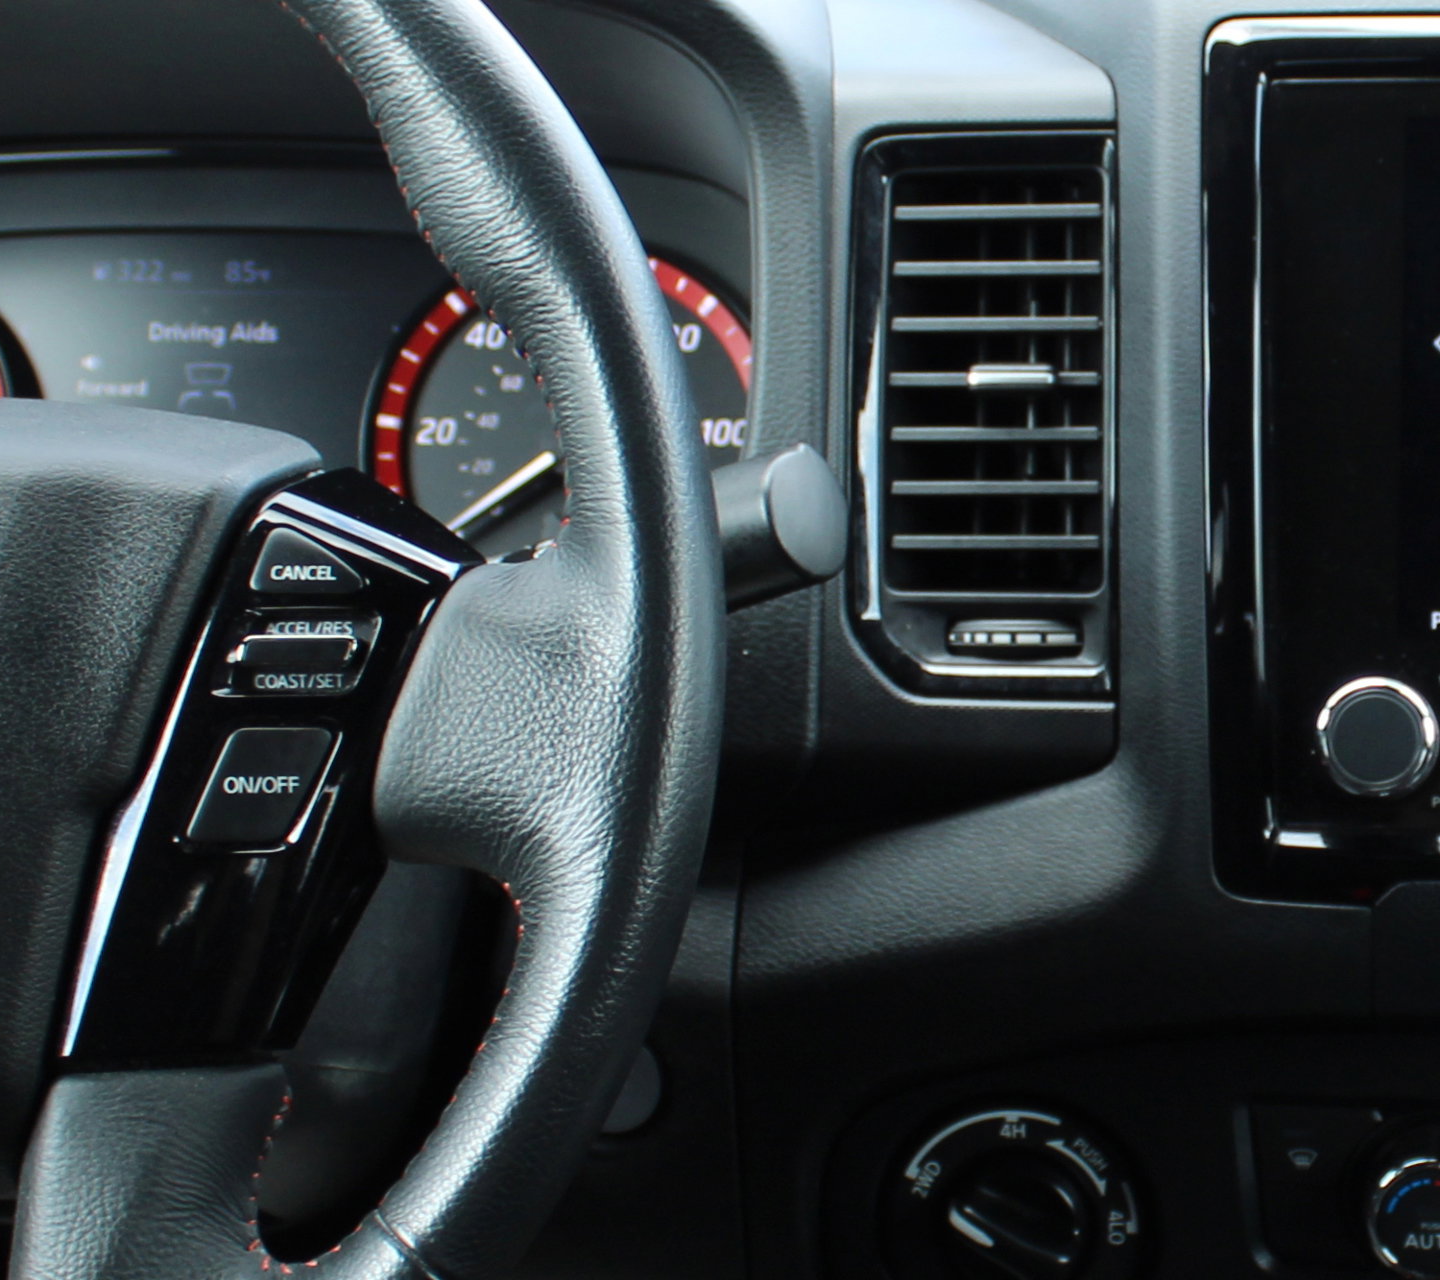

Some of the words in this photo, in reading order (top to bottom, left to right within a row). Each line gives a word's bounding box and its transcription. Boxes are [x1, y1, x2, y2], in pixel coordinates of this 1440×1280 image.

[148, 321, 227, 348] Driving
[230, 321, 280, 343] Aids
[464, 322, 506, 351] 40
[415, 418, 457, 446] 20
[471, 459, 495, 475] 20
[270, 565, 336, 581] CANCEL
[265, 621, 353, 636] ACCEL/RES
[254, 674, 344, 689] COAST/SET
[223, 776, 300, 794] ON/OFF
[999, 1123, 1027, 1139] 4H
[1072, 1137, 1109, 1172] PUSH
[912, 1161, 942, 1199] 2WD
[1108, 1210, 1126, 1246] 4LO
